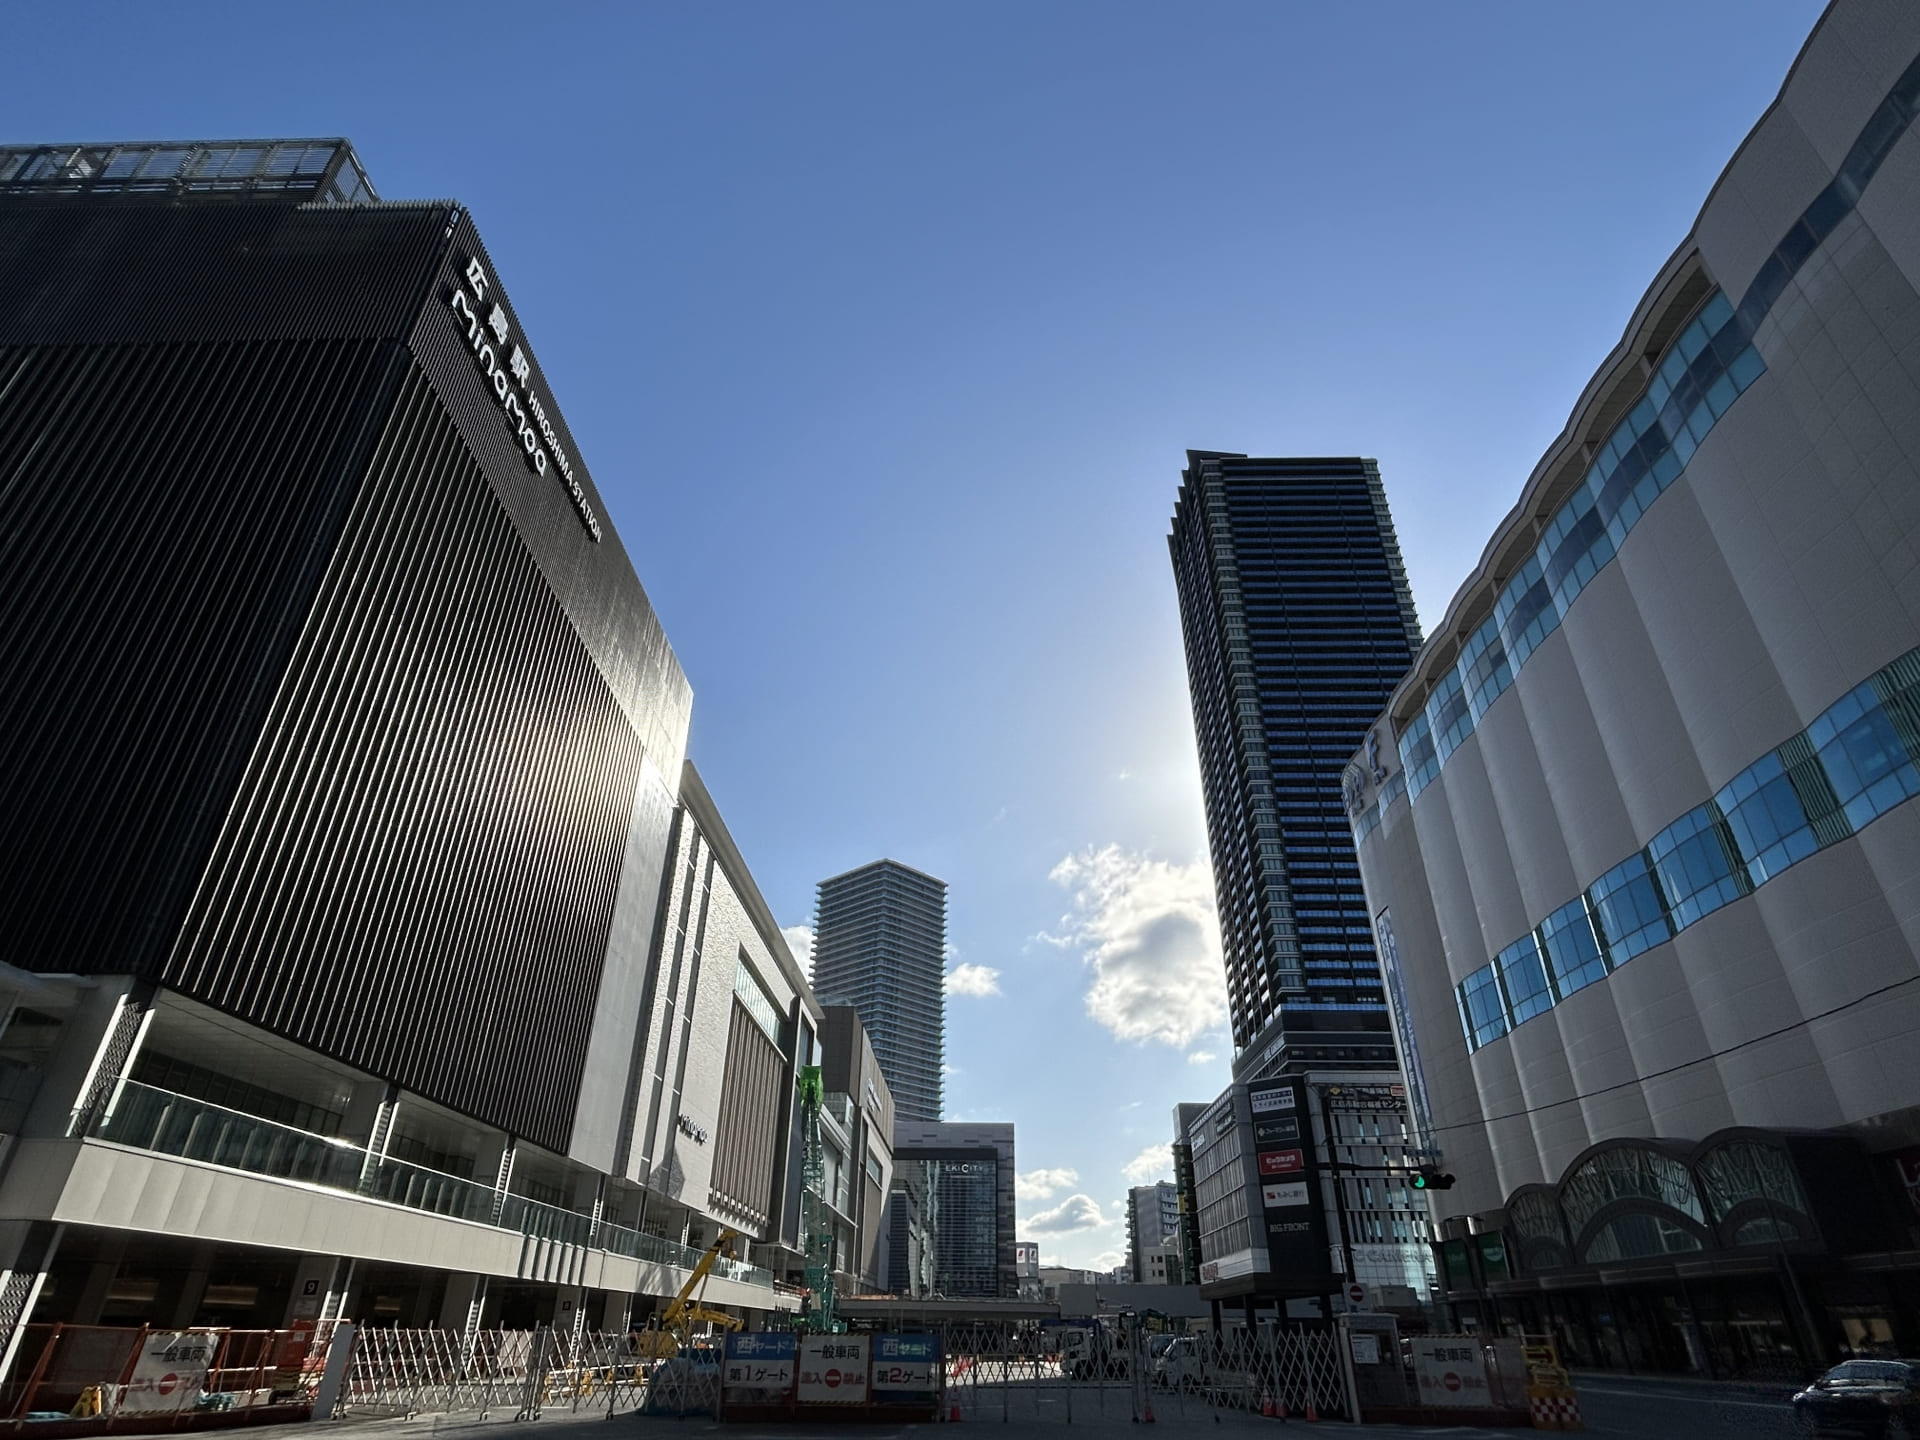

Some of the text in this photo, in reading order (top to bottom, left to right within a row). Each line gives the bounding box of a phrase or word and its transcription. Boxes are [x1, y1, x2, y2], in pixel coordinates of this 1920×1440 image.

[465, 256, 530, 388] 広島駅
[528, 390, 602, 544] HIROSHIMA STATION
[151, 1345, 208, 1363] 一般車両
[735, 1335, 787, 1355] 西ヤード
[809, 1344, 860, 1360] 一般車両
[881, 1337, 932, 1357] 西ヤード
[1422, 1347, 1473, 1363] 一般車両
[729, 1364, 788, 1382] 第1ゲート
[876, 1367, 933, 1384] 第2ゲート
